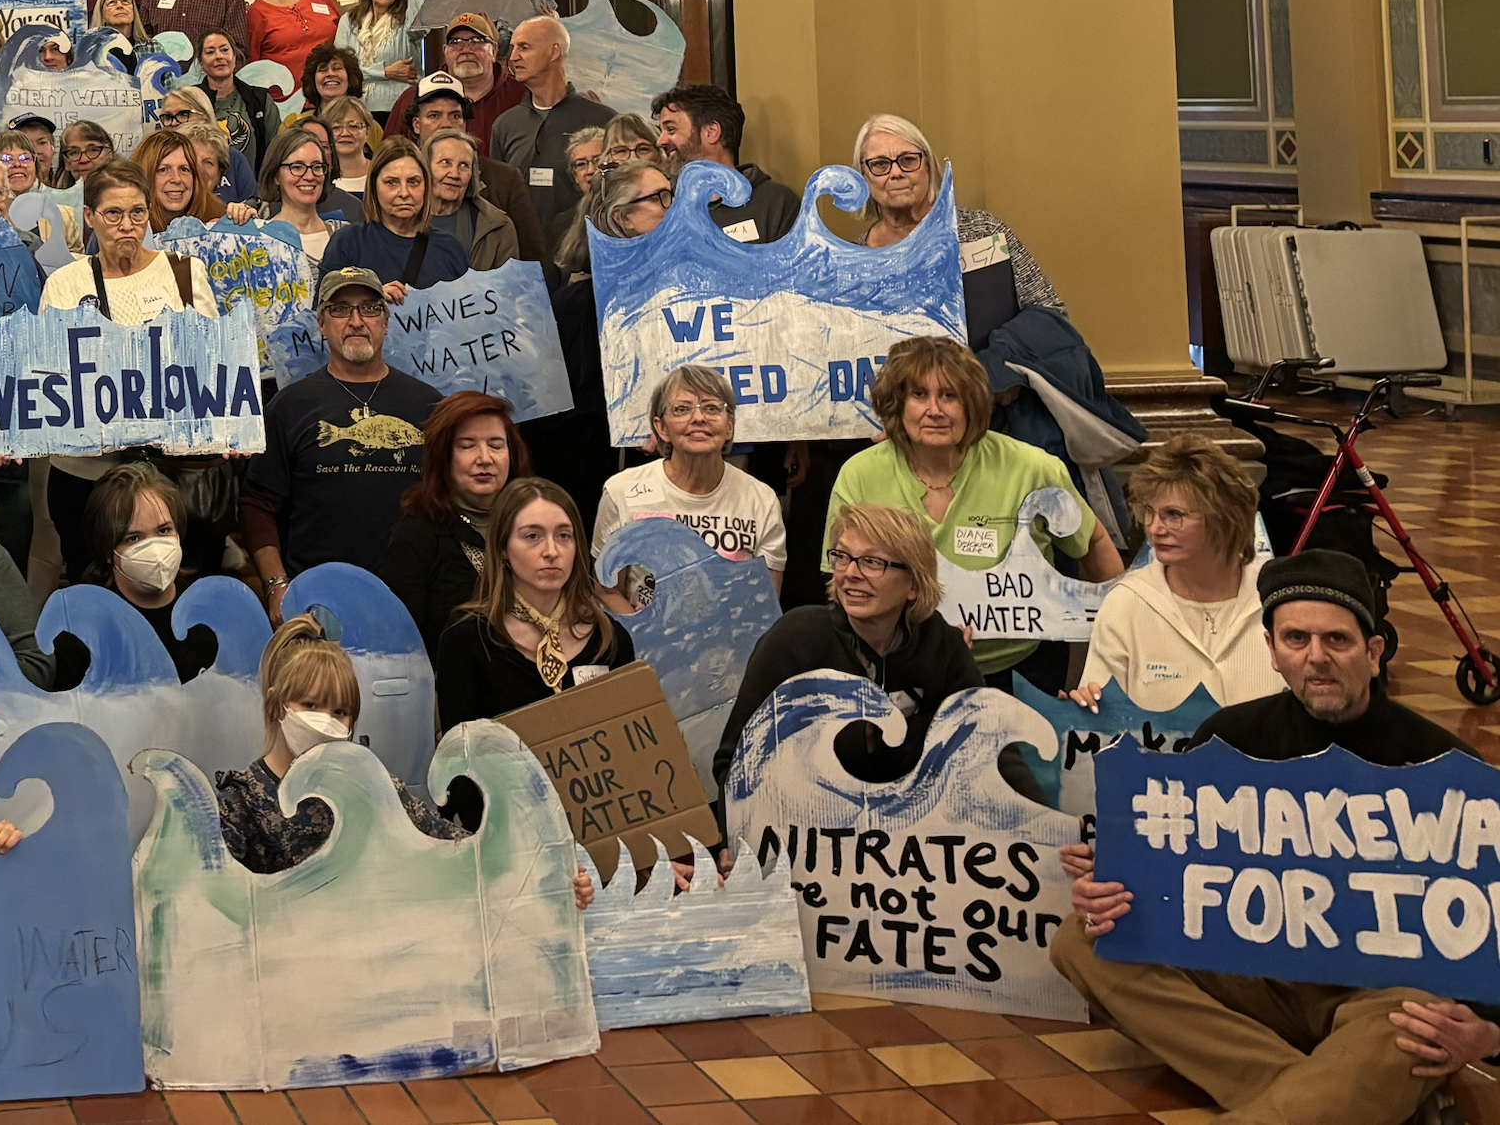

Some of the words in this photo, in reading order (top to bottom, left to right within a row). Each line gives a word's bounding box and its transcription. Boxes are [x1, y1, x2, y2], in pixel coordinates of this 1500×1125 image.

[6, 89, 66, 107] DIRTY
[71, 89, 142, 107] WATER
[54, 111, 79, 130] IS
[394, 289, 498, 334] WAVES
[661, 303, 735, 344] WE
[411, 329, 521, 376] WATER
[316, 464, 340, 474] Save
[343, 463, 361, 474] The
[364, 463, 408, 474] Raccoon
[675, 514, 721, 529] MUST
[725, 517, 757, 534] LOVE
[694, 530, 757, 553] OOP!
[956, 529, 995, 541] DIANE
[986, 572, 1033, 599] BAD
[958, 603, 1044, 632] WATER
[543, 730, 611, 779] HAT'S
[623, 715, 659, 752] IN
[569, 768, 624, 804] OUR
[850, 882, 937, 921] not
[962, 899, 1063, 948] our
[1182, 863, 1341, 950] FOR
[1347, 871, 1500, 967] IO
[17, 925, 132, 991] WATER
[816, 915, 1002, 982] FATES
